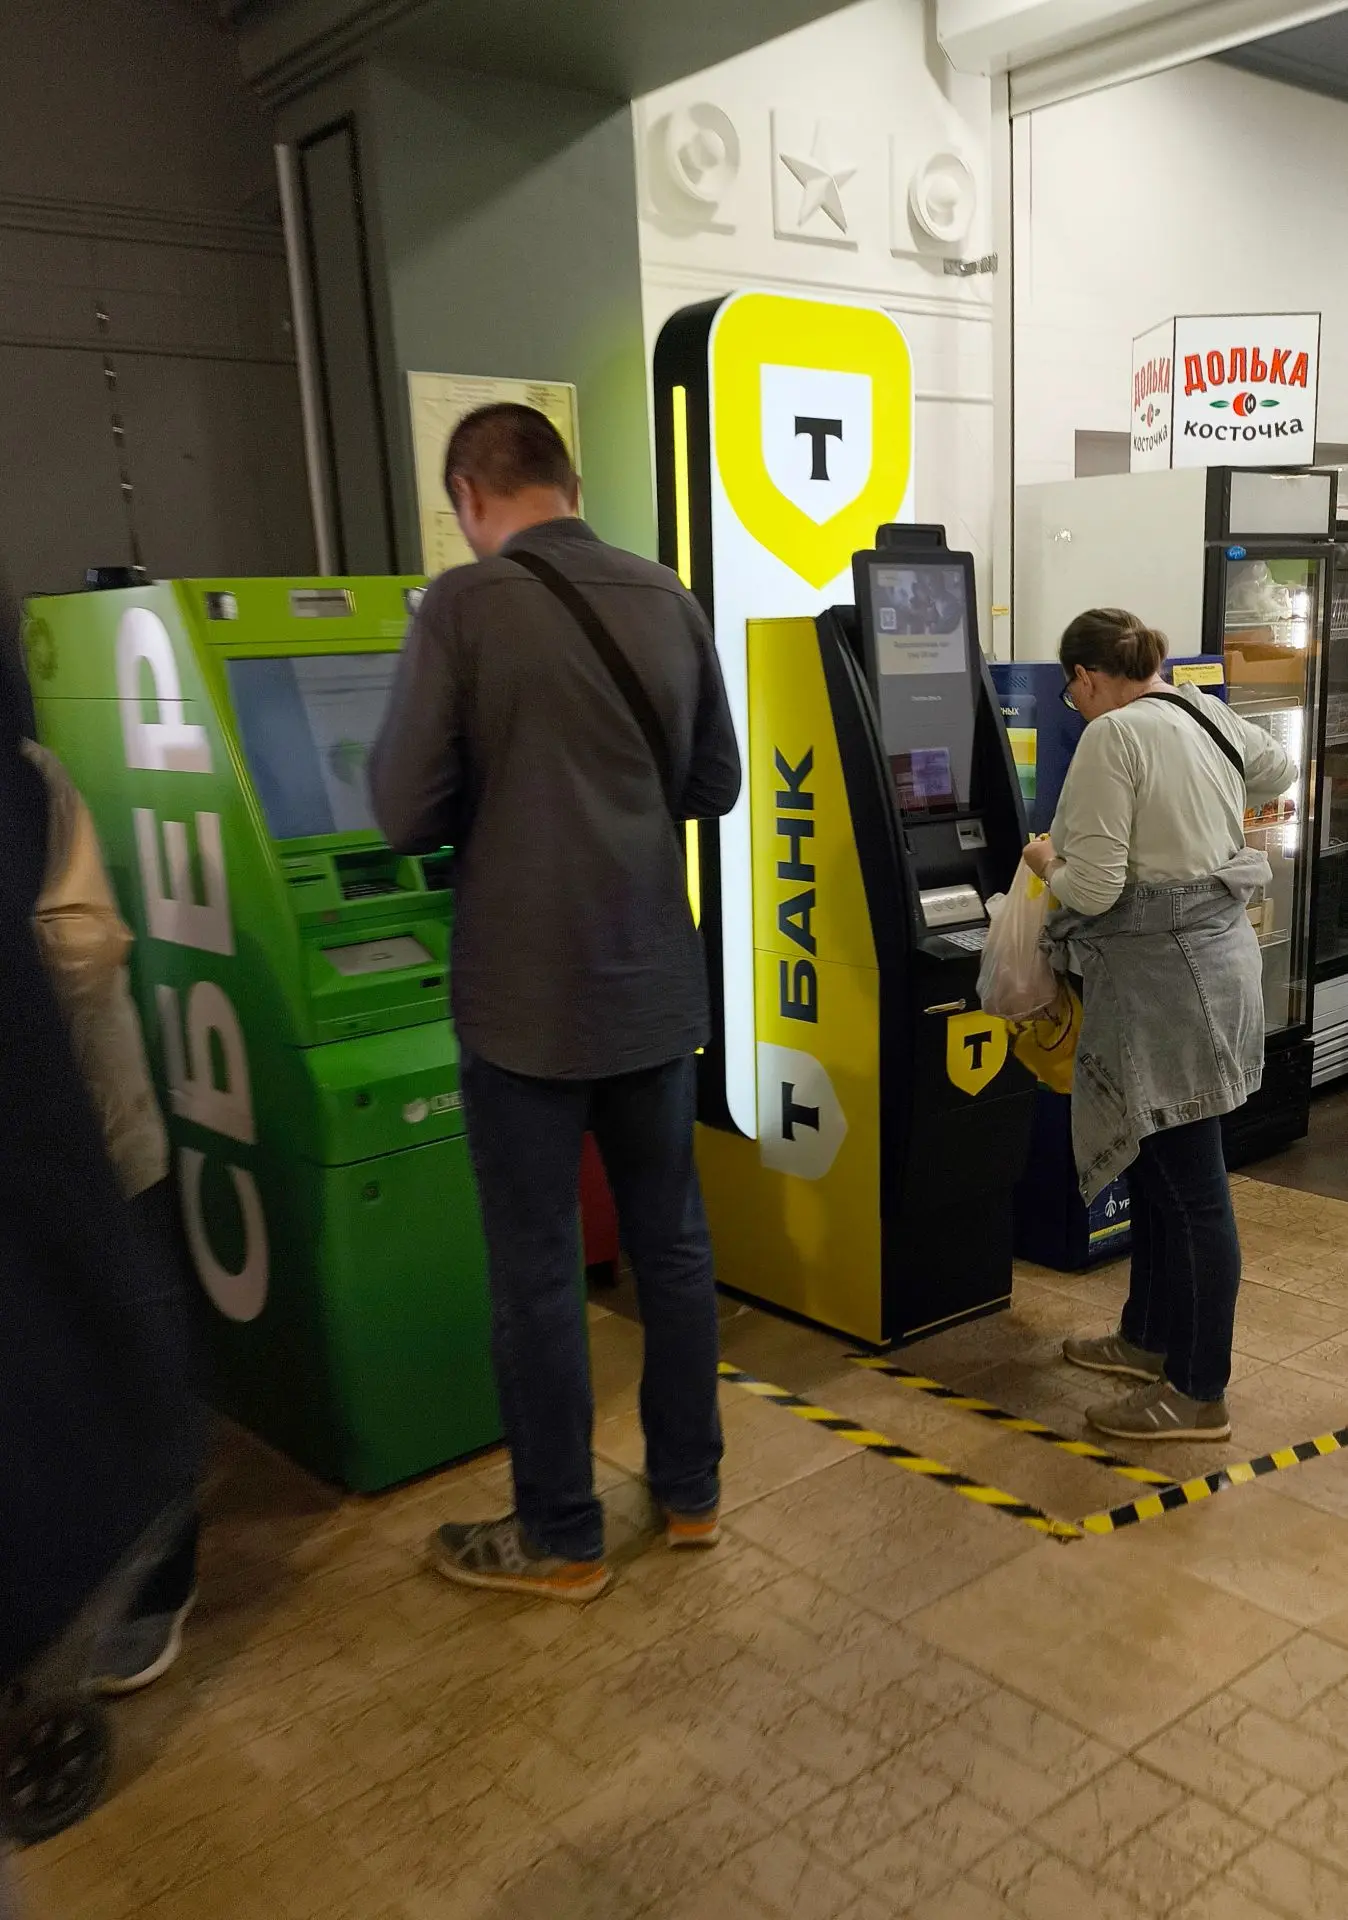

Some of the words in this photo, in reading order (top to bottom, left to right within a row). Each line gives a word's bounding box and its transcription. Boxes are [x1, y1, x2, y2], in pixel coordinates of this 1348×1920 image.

[1134, 356, 1171, 412] ДОЛЬКА
[1184, 346, 1309, 397] ДОЛЬКА
[794, 415, 843, 481] Т
[1133, 424, 1168, 452] косточка
[1184, 418, 1304, 441] косточка
[775, 744, 818, 1024] БАНК
[115, 606, 269, 1322] СБЕР
[964, 1030, 992, 1070] Т
[781, 1081, 820, 1142] Т
